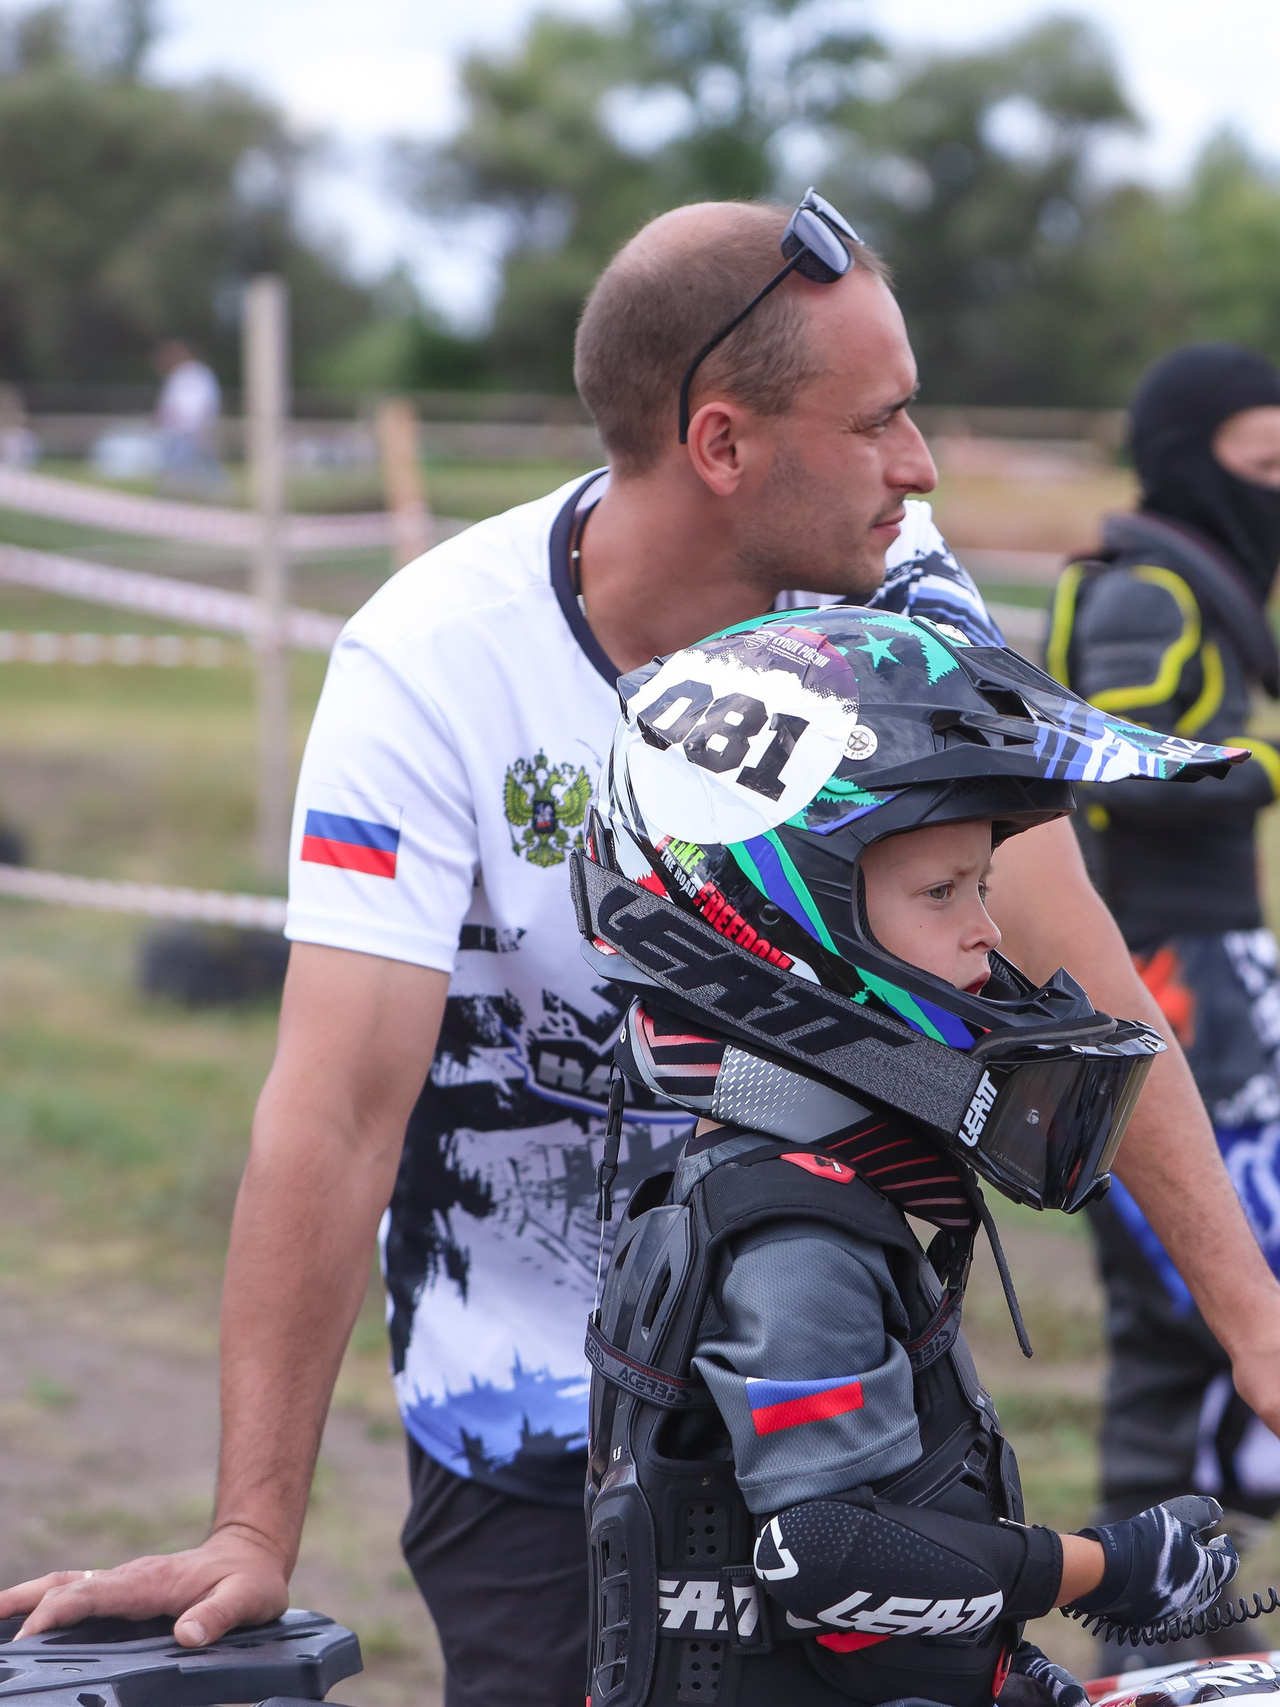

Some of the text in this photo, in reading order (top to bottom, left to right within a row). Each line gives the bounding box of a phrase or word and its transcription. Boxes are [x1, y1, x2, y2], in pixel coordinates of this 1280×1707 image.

[772, 636, 803, 653] КУБОК
[637, 679, 810, 802] 081
[660, 850, 697, 899] THE ROAD
[958, 1070, 998, 1147] LEATT
